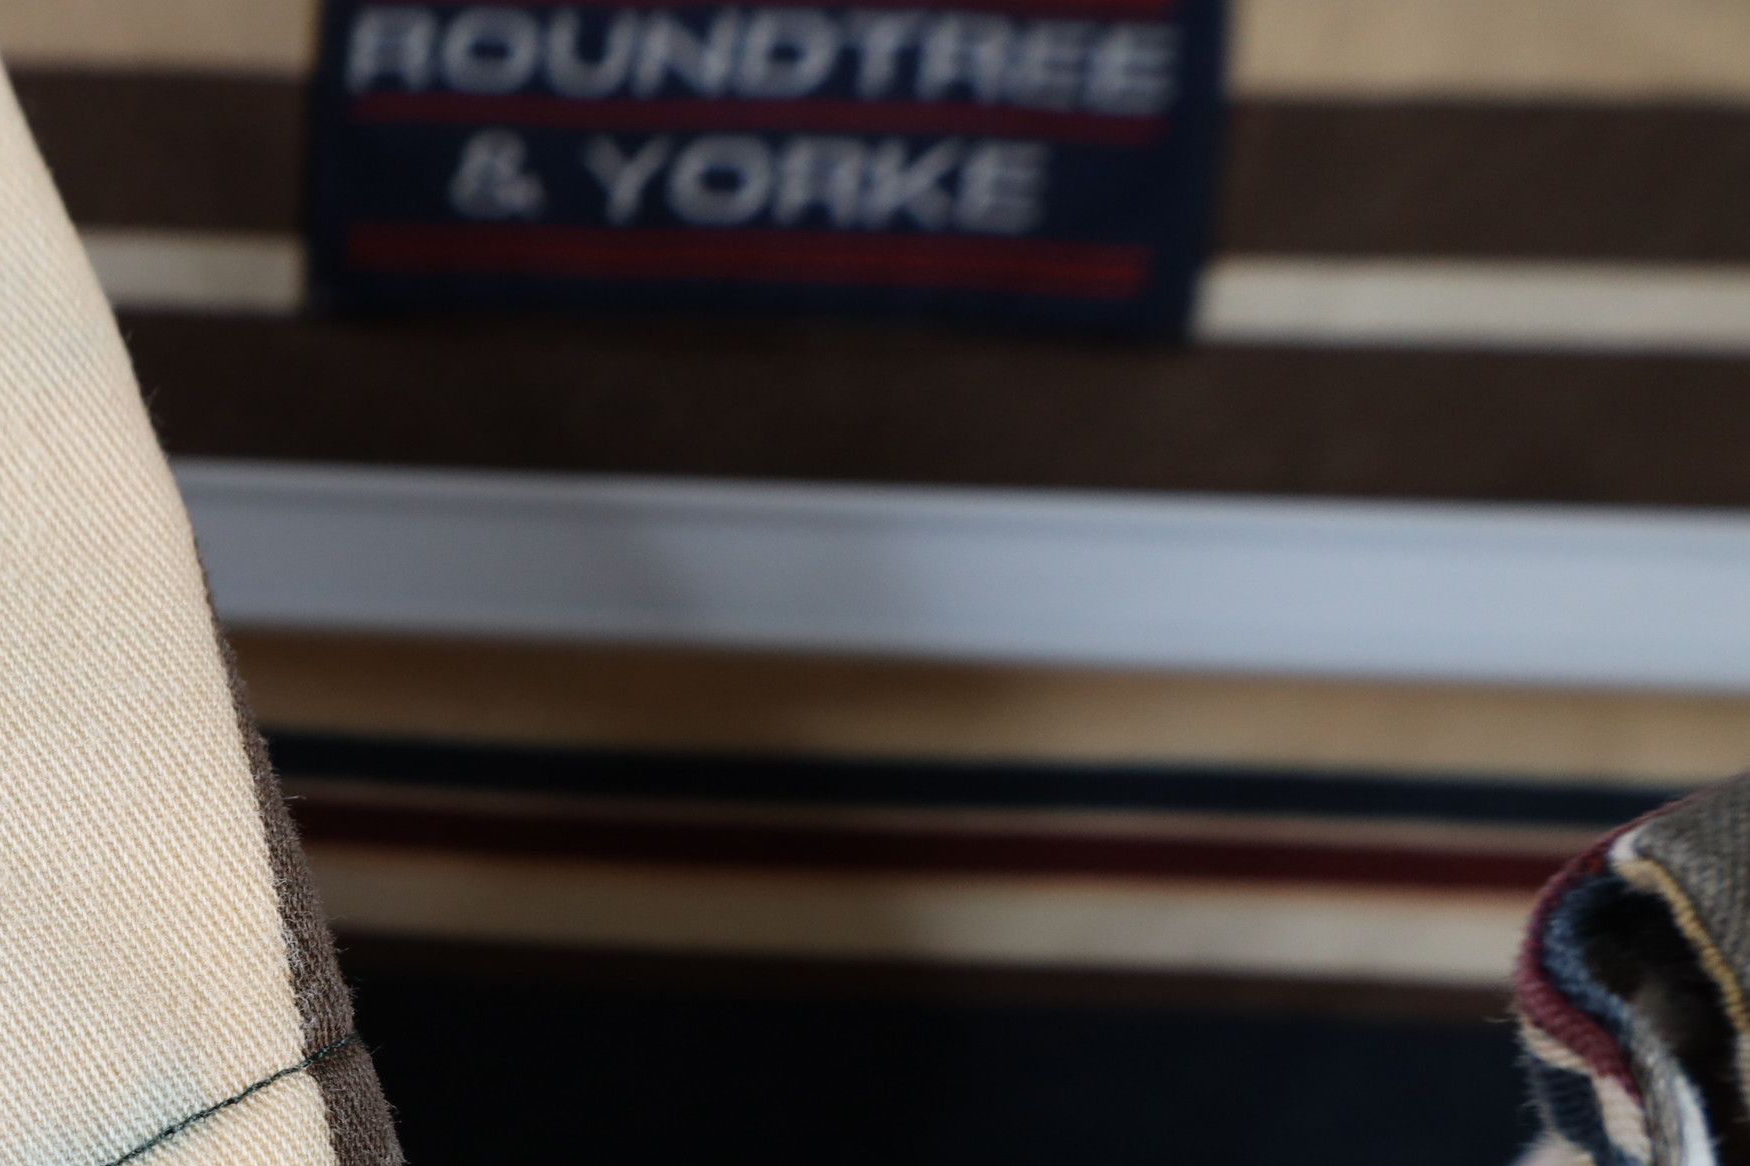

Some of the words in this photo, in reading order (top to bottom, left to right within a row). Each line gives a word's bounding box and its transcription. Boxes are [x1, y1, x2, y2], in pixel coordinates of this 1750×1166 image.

[344, 7, 1181, 116] ROUNDTREE
[450, 129, 545, 222] &
[583, 133, 1052, 236] YORKE
